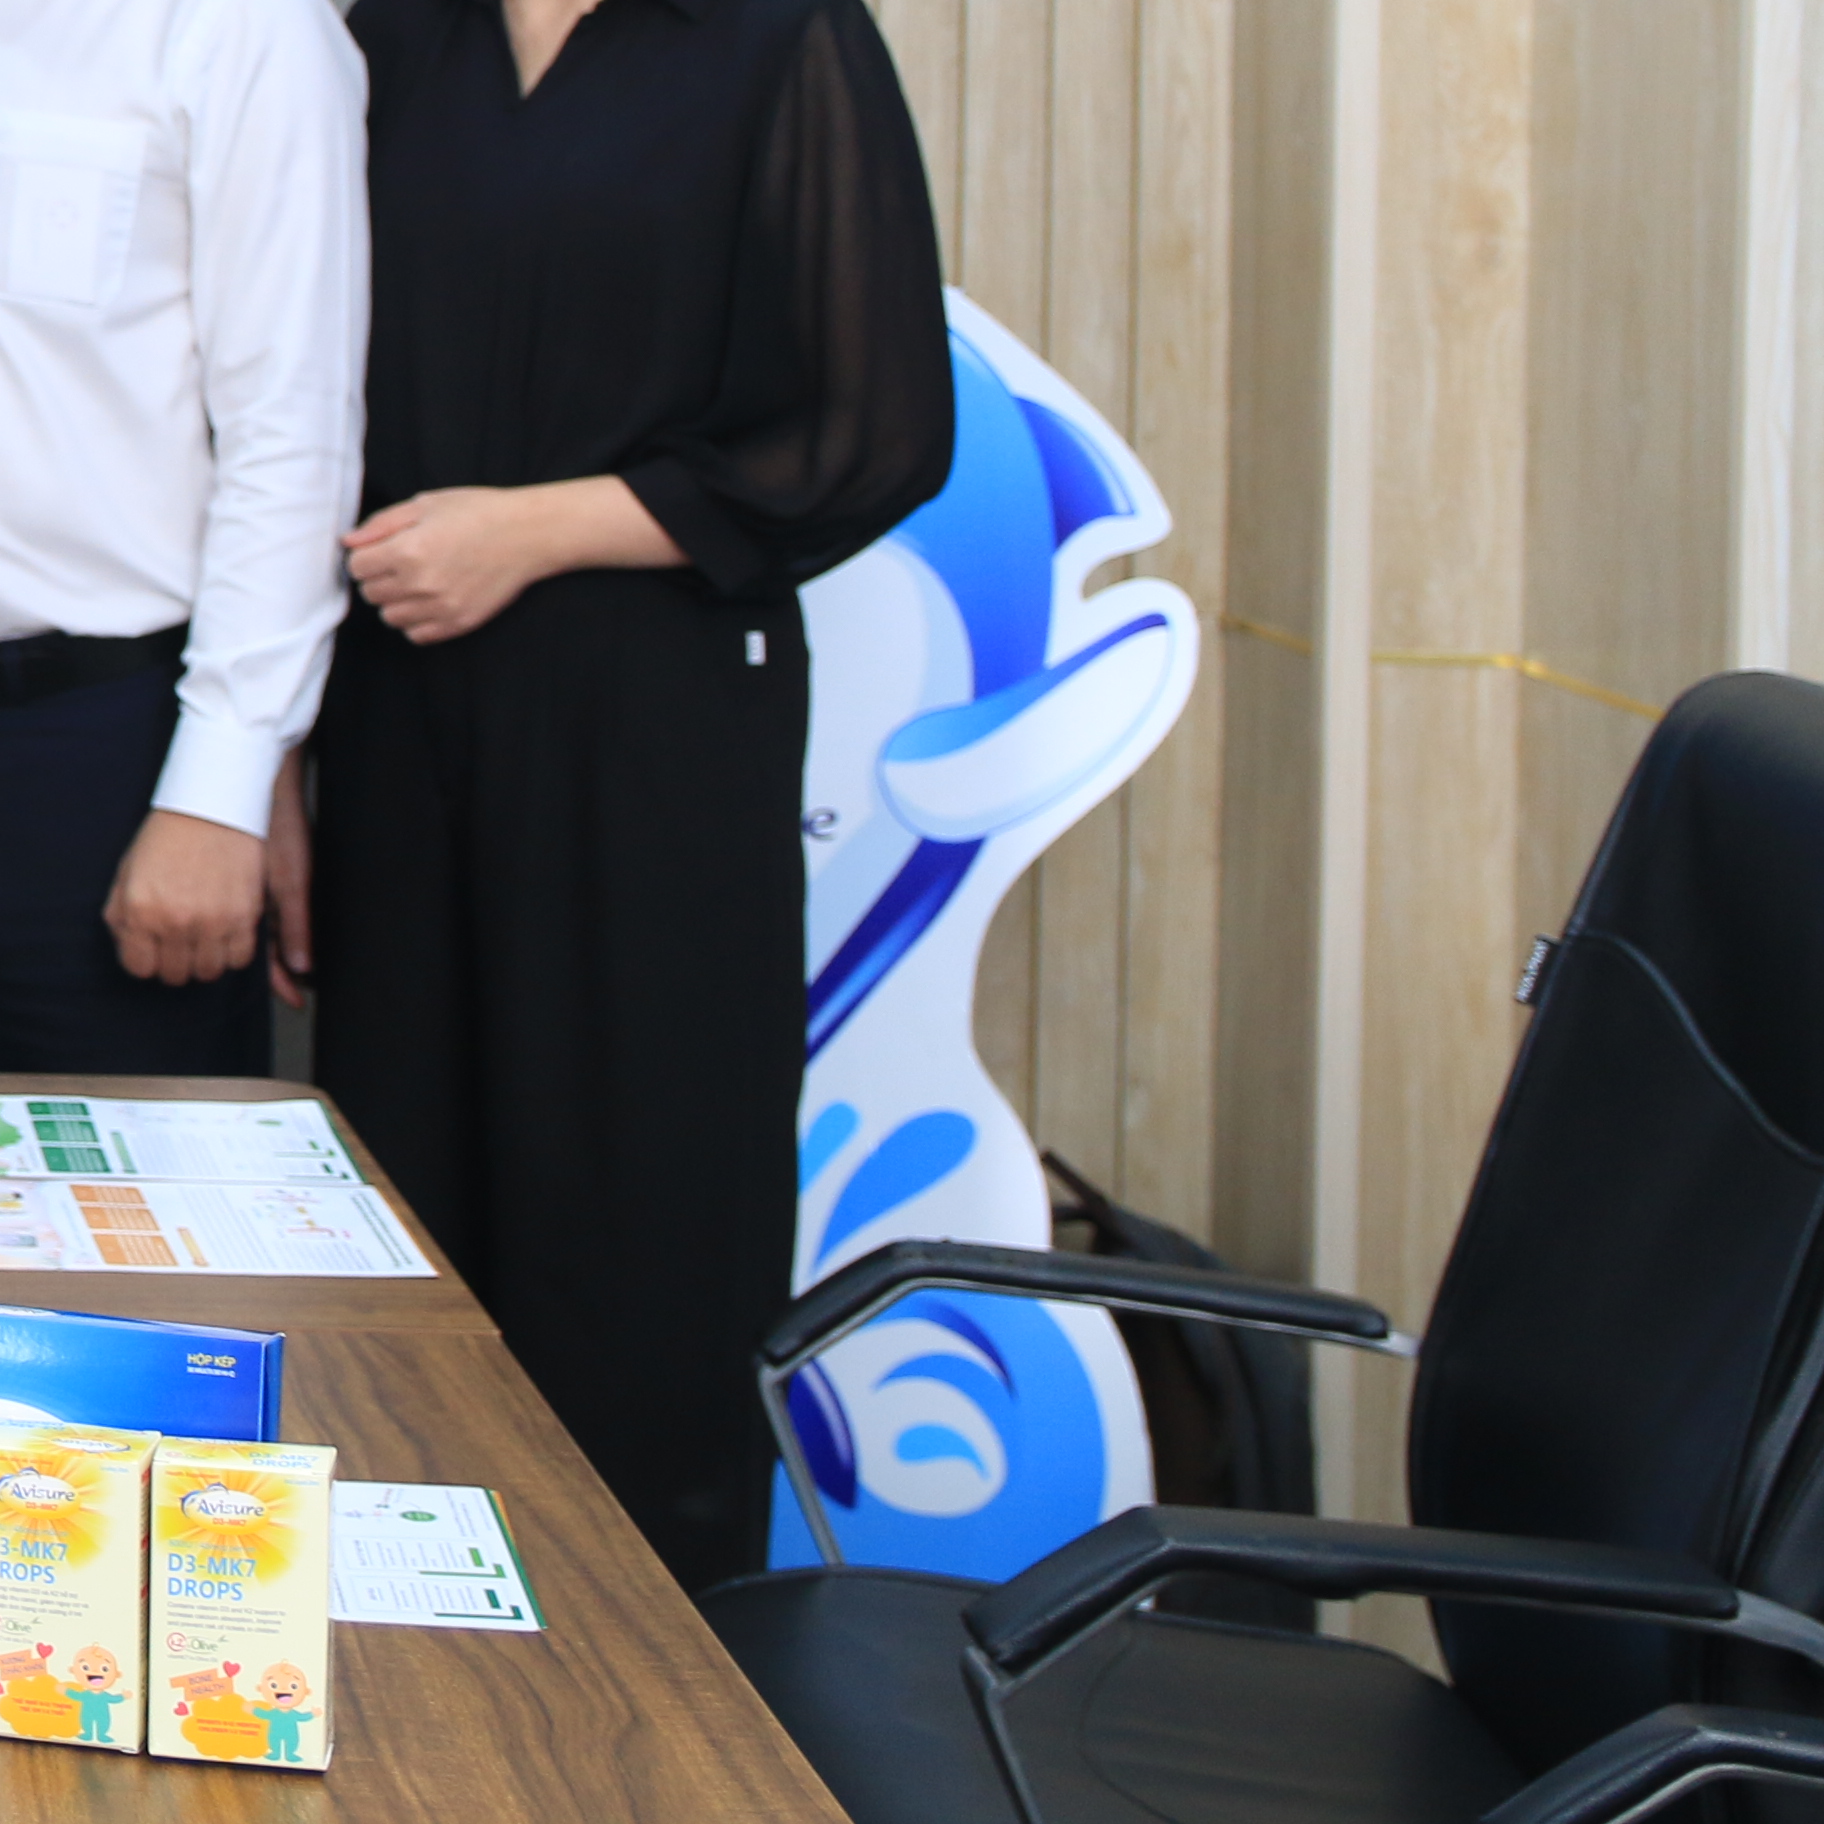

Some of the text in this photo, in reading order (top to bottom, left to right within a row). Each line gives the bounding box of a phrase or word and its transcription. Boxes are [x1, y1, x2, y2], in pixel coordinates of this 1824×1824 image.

[186, 1353, 238, 1368] HỘP KÉP
[11, 1482, 76, 1502] Avisure
[197, 1499, 265, 1517] Avisure
[167, 1552, 257, 1578] D3-MK7
[167, 1577, 244, 1601] DROPS
